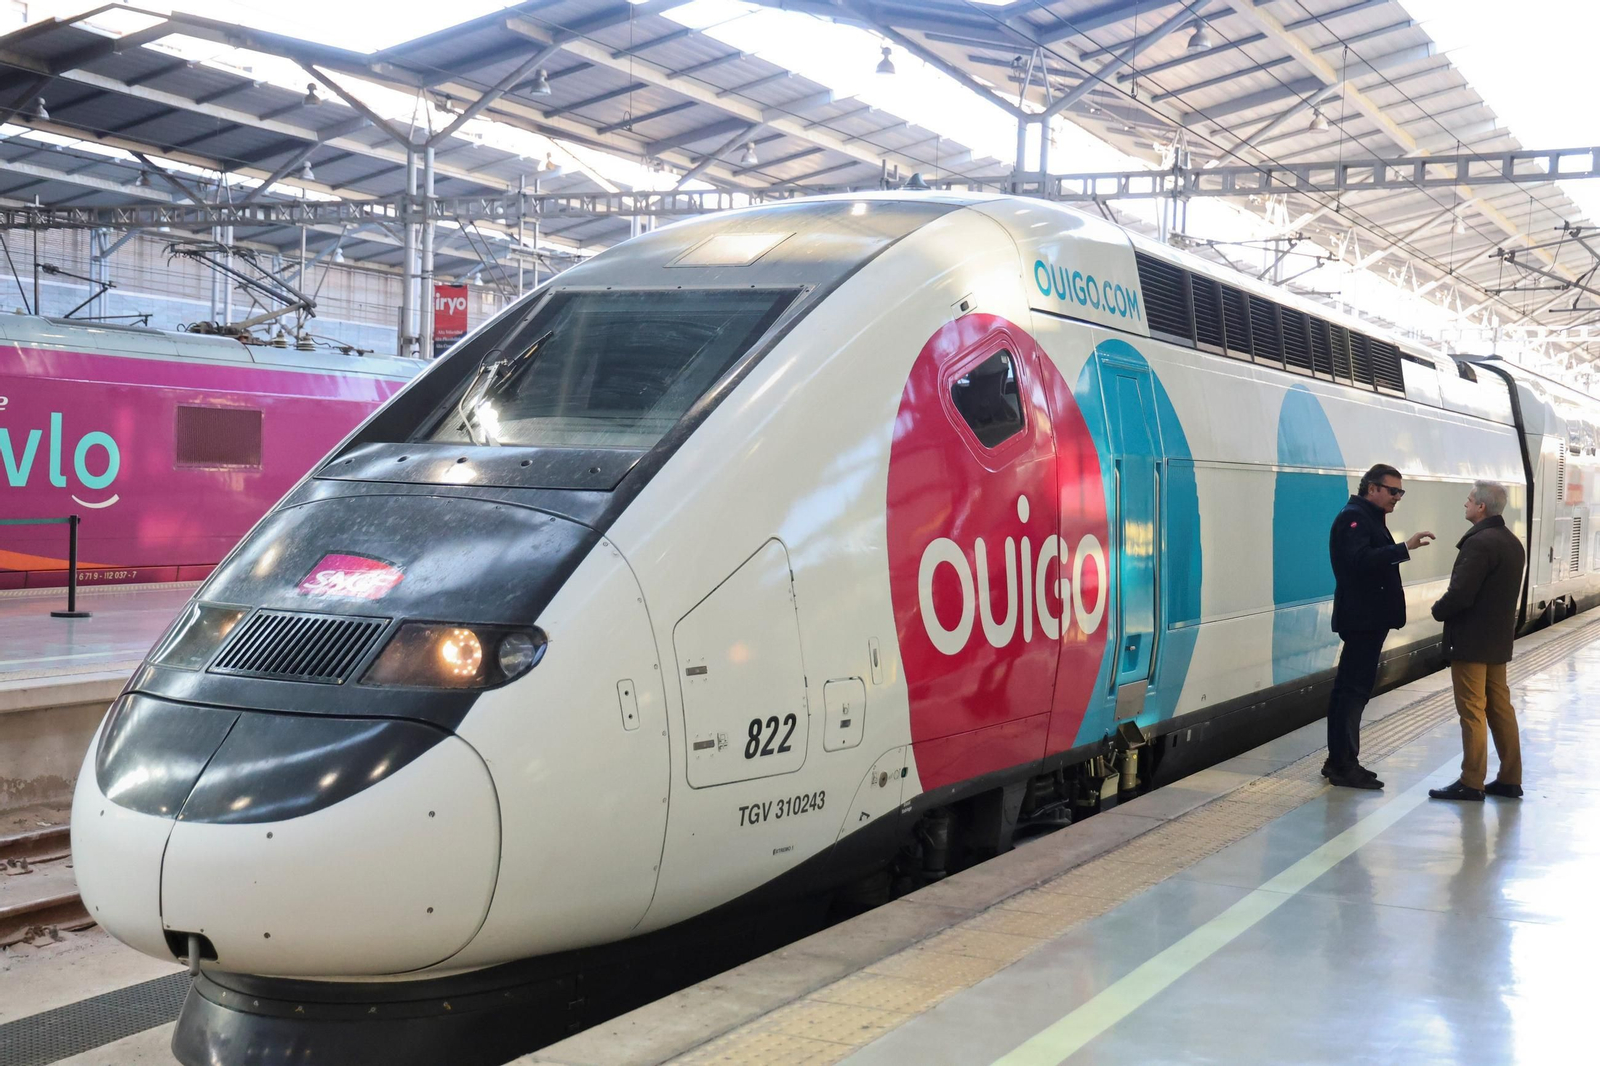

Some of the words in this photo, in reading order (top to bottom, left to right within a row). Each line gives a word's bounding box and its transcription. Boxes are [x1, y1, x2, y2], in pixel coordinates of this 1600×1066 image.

[435, 292, 467, 316] iryo
[1034, 259, 1141, 322] OUIGO.COM
[744, 713, 797, 760] 822
[738, 801, 773, 827] TGV
[775, 790, 826, 819] 310243
